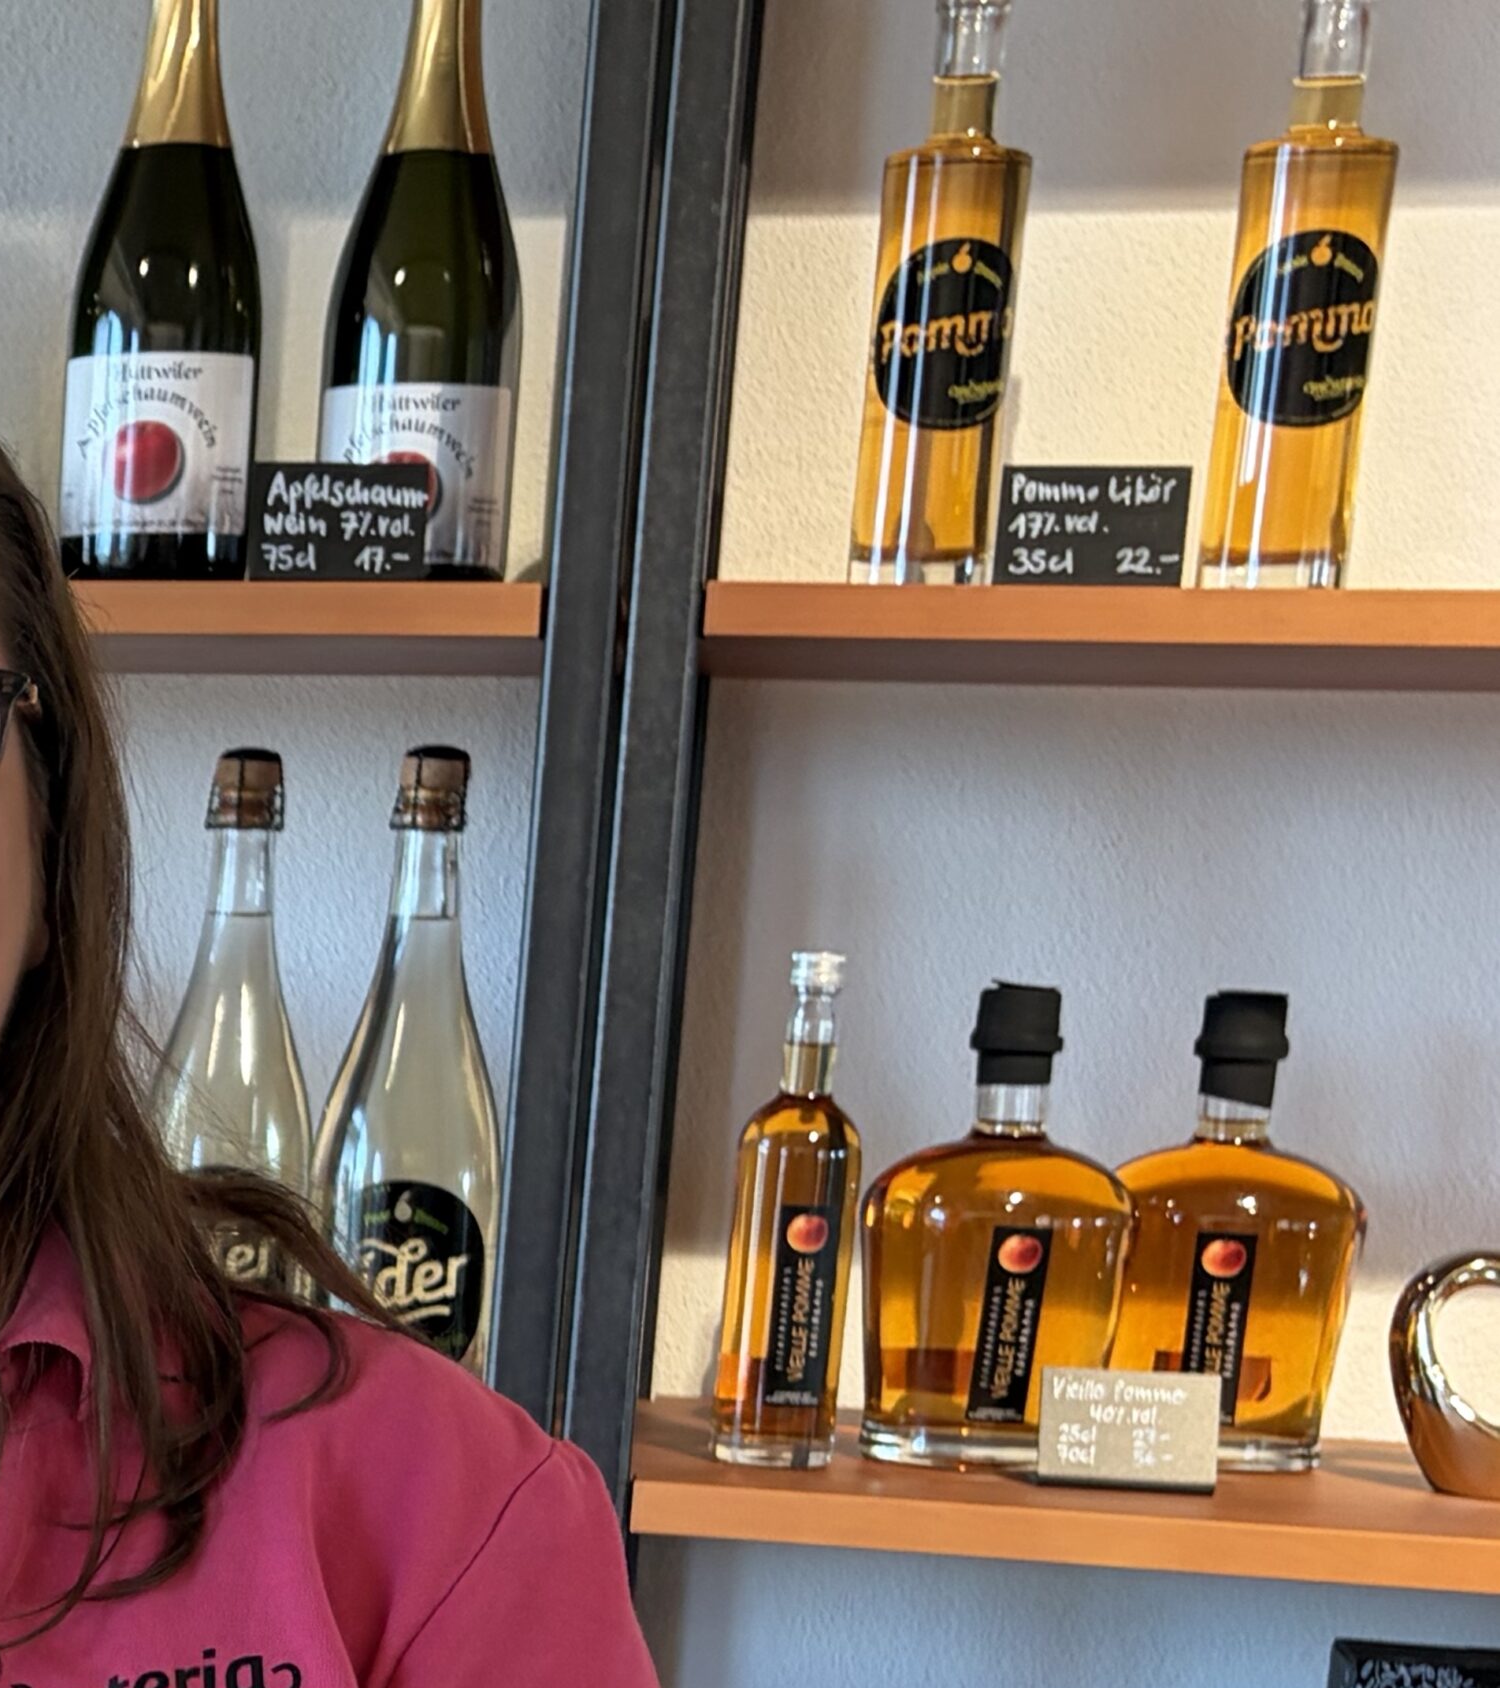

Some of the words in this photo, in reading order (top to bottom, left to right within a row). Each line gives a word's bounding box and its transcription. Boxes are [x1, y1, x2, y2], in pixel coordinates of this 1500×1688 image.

[343, 413, 480, 479] pfelschaumwein
[1108, 473, 1177, 507] Likör
[261, 542, 316, 572] 75cl
[1008, 547, 1074, 575] 35cl
